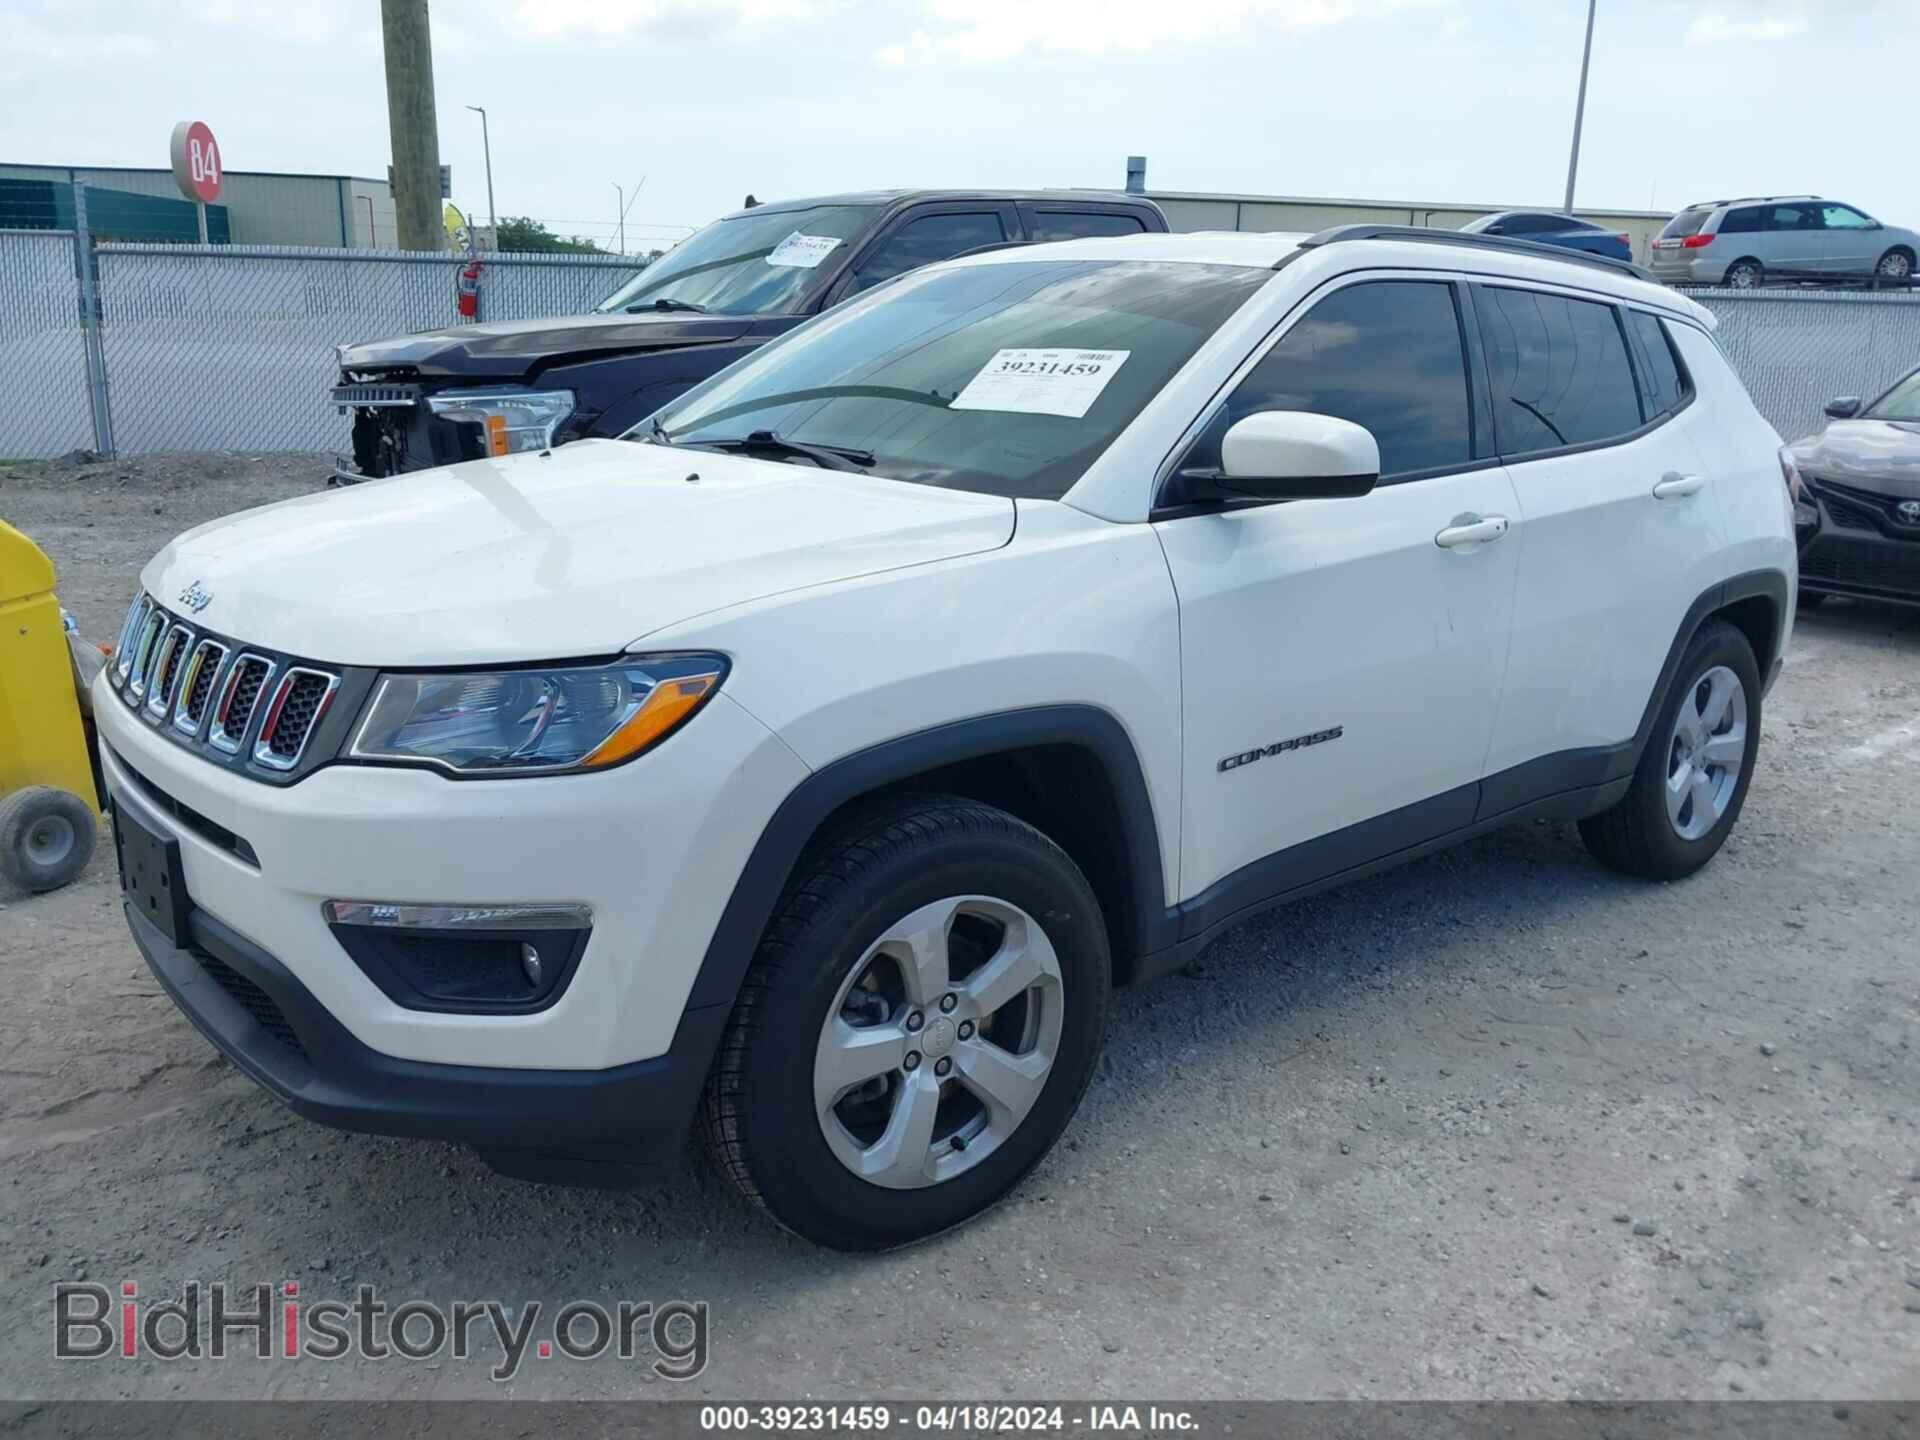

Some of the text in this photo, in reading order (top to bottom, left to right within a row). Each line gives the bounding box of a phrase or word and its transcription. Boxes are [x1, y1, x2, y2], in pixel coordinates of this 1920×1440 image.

[190, 138, 218, 185] 84
[992, 359, 1102, 377] 39231459
[1217, 725, 1344, 773] COMPASS
